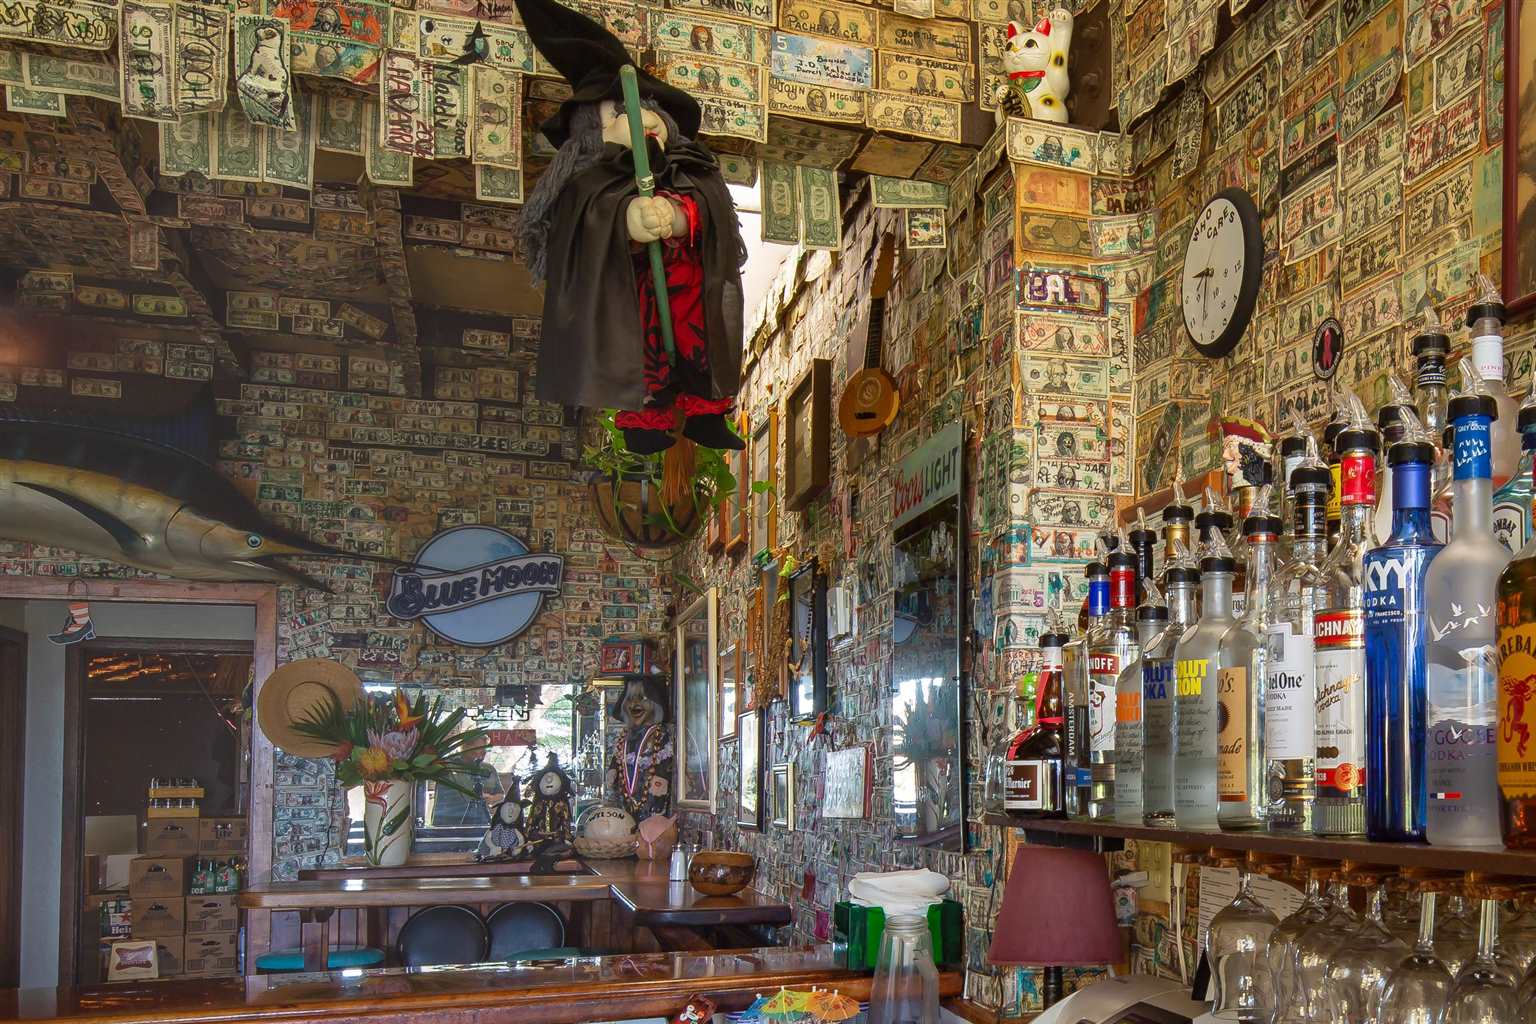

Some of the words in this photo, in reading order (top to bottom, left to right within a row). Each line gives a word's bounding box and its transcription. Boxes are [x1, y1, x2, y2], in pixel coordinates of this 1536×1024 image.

[776, 36, 788, 50] 5
[1192, 207, 1212, 242] WHO
[1206, 205, 1235, 239] CARES
[925, 446, 959, 498] LIGHT
[394, 575, 479, 617] BLUE
[479, 560, 561, 598] MOON
